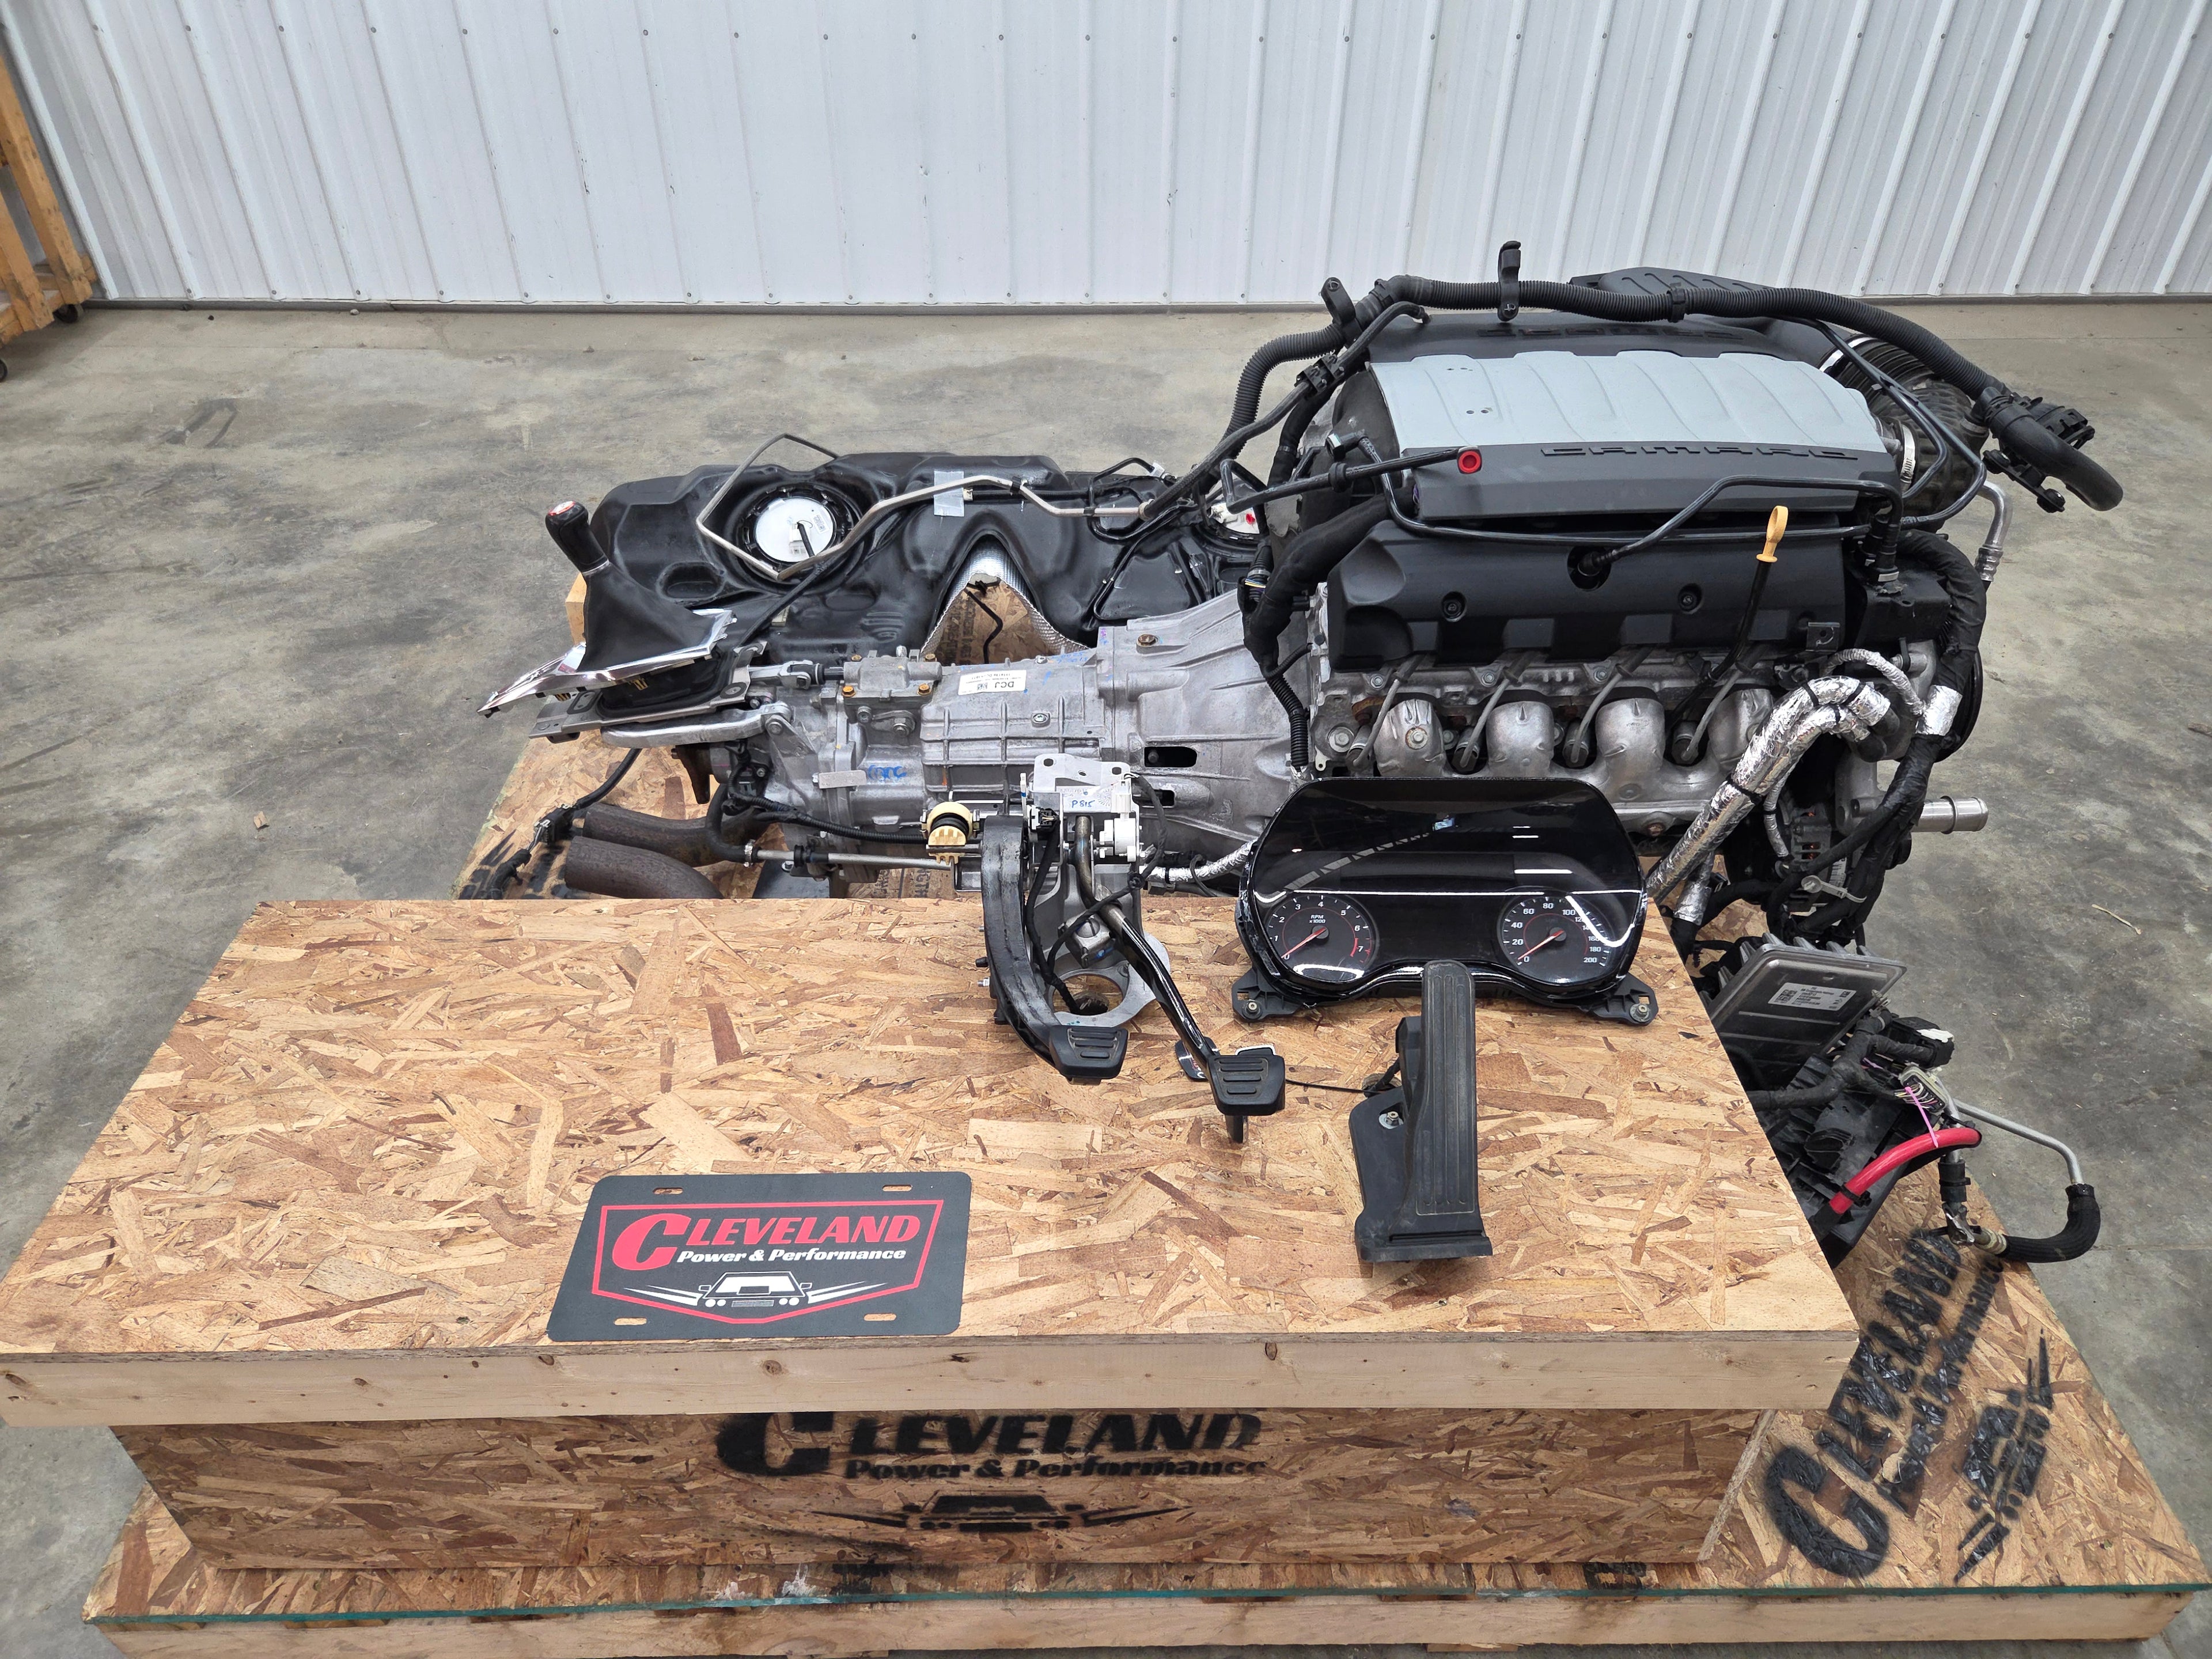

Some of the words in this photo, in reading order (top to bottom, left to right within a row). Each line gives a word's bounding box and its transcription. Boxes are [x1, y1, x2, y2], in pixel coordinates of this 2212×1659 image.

[1540, 446, 1858, 460] CAMARO
[612, 1213, 921, 1271] CLEVELAND
[677, 1251, 747, 1263] Power
[749, 1249, 764, 1262] &
[768, 1248, 907, 1262] Performance
[1766, 1228, 1962, 1579] CLEVELAND
[717, 1411, 1262, 1476] CLEVELAND
[844, 1459, 971, 1479] Power
[978, 1459, 1003, 1478] &
[1013, 1456, 1267, 1478] Performance
